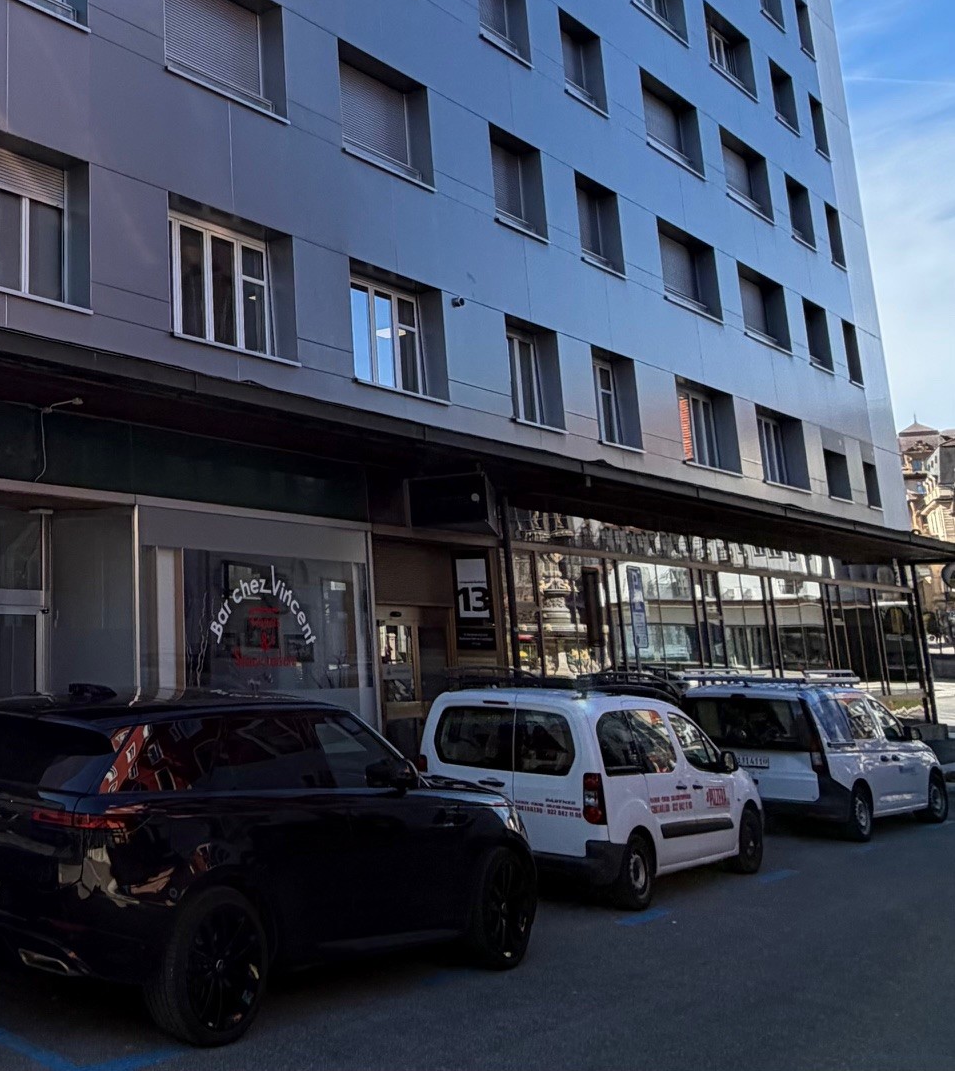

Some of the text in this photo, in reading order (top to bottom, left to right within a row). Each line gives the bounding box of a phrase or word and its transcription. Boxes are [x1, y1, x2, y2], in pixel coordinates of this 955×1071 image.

[210, 564, 317, 645] Bar chez Vincent
[458, 586, 490, 612] 13
